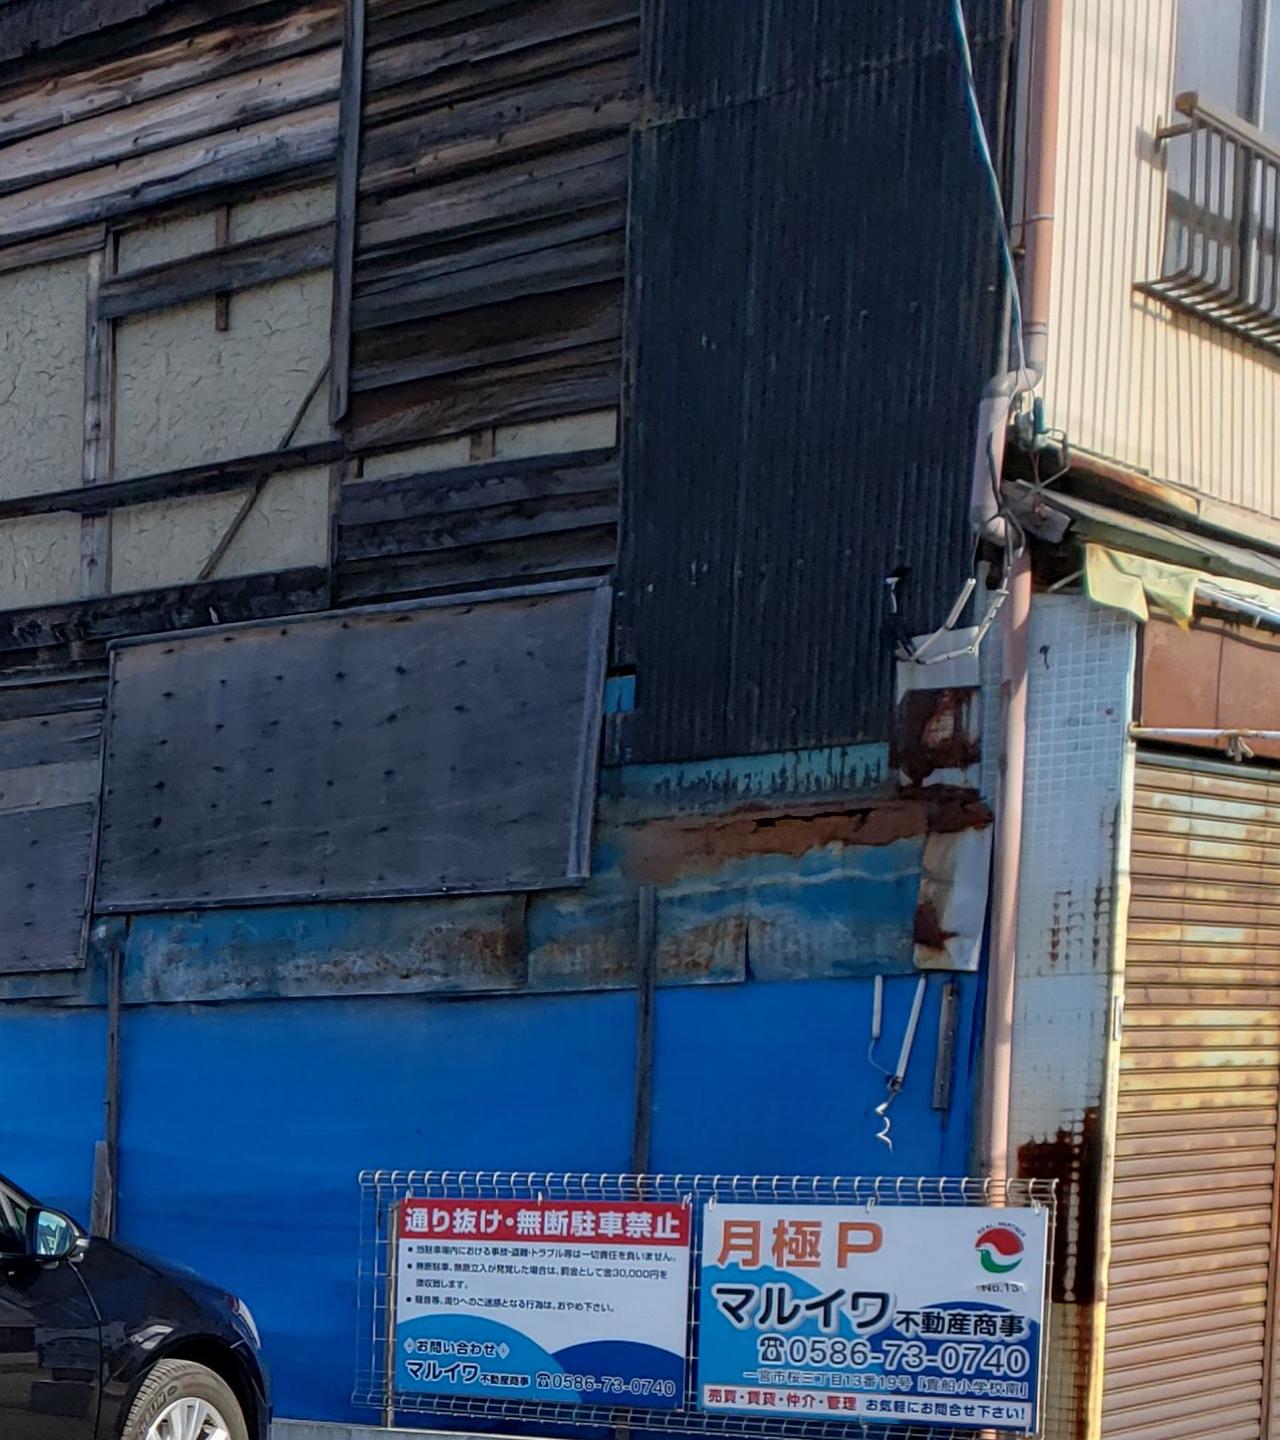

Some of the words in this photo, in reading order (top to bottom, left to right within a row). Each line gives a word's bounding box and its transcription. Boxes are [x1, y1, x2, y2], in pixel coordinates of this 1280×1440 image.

[405, 1207, 680, 1239] 通り抜け・無断駐車禁止
[416, 1340, 496, 1357] お問い合わせ
